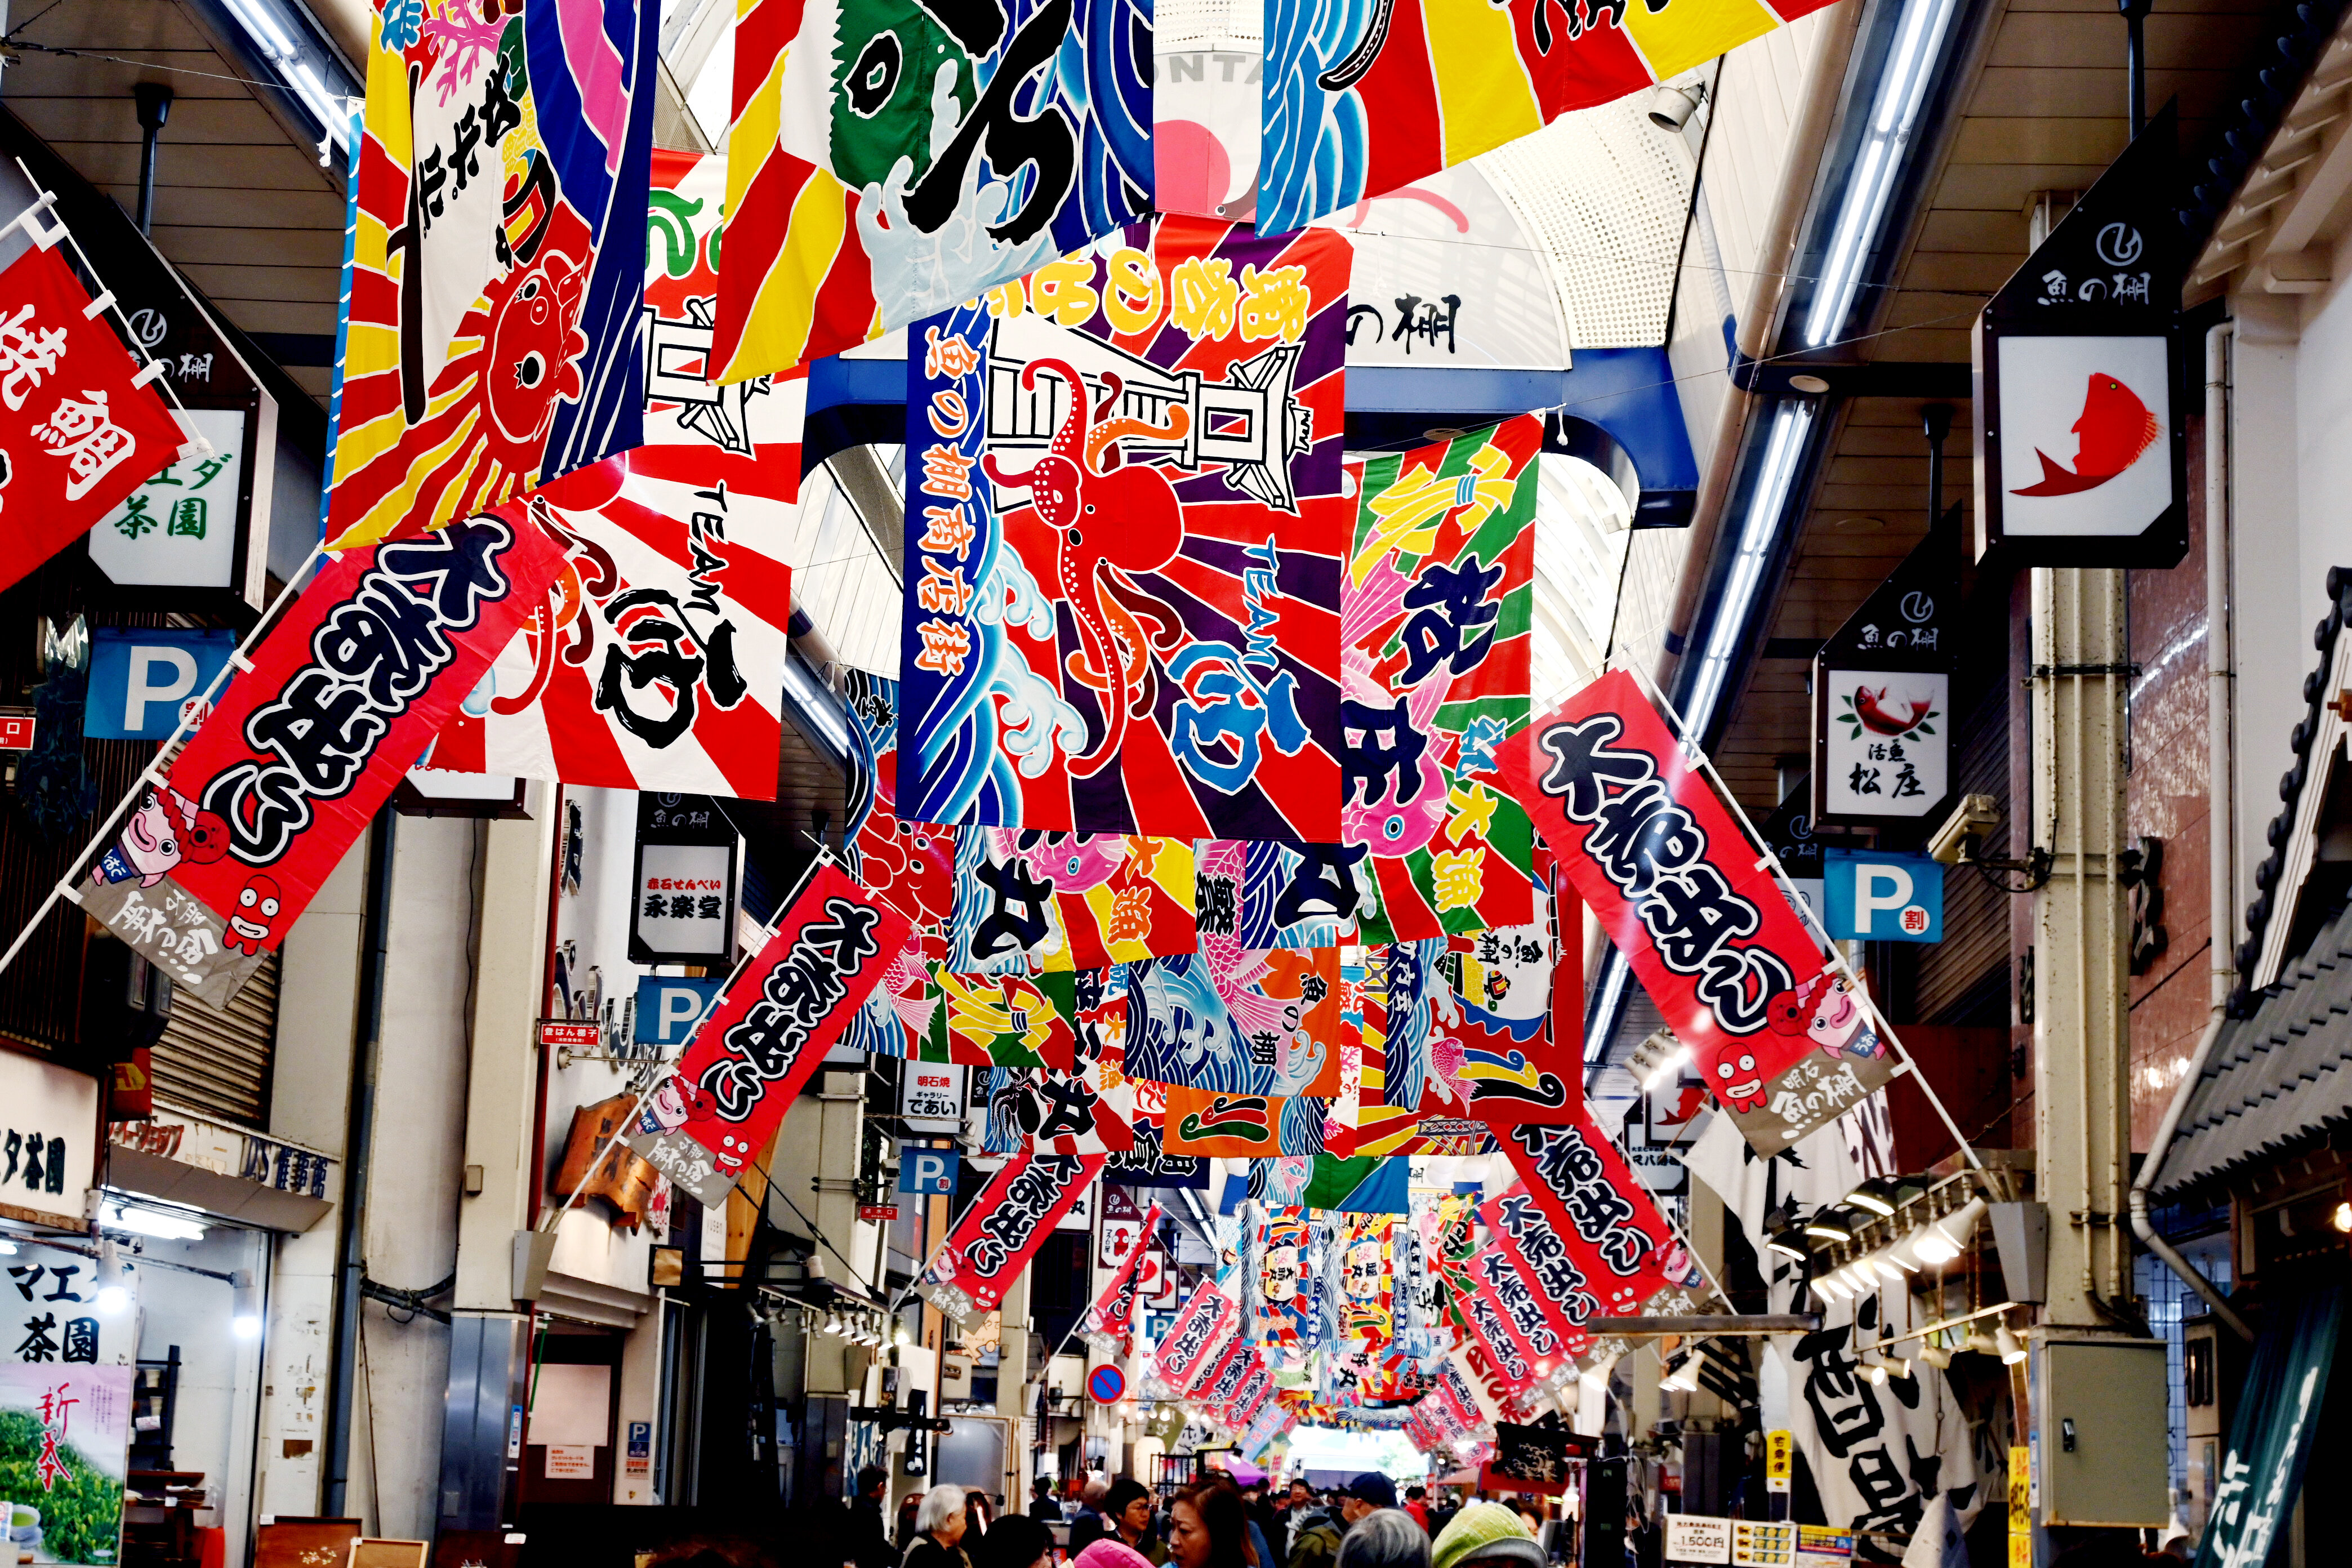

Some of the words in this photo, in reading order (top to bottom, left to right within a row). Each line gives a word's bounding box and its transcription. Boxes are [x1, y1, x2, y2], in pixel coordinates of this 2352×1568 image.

[2037, 269, 2151, 306] 魚の棚
[114, 495, 207, 540] 茶園
[915, 326, 981, 676] 魚の棚商店街
[683, 482, 728, 616] TEAM
[1241, 533, 1281, 674] TEAM
[1857, 623, 1939, 651] 魚の棚
[124, 645, 197, 732] P
[1868, 738, 1907, 763] 活魚
[1850, 762, 1926, 799] 松庄
[651, 809, 710, 830] 魚の棚
[643, 895, 723, 921] 永楽堂
[1855, 863, 1914, 934] P
[1904, 910, 1926, 932] 割
[1477, 932, 1544, 968] 魚の棚
[658, 987, 702, 1040] P
[1250, 970, 1329, 1069] 魚の棚
[544, 1027, 598, 1038] 登はん梯子
[917, 1075, 950, 1088] 明石焼
[907, 1099, 956, 1116] であい
[914, 1155, 945, 1190] P
[938, 1178, 950, 1190] 割
[14, 1312, 100, 1365] 茶園
[1154, 1323, 1168, 1338] P
[35, 1382, 80, 1492] 新茶
[633, 1424, 647, 1440] P
